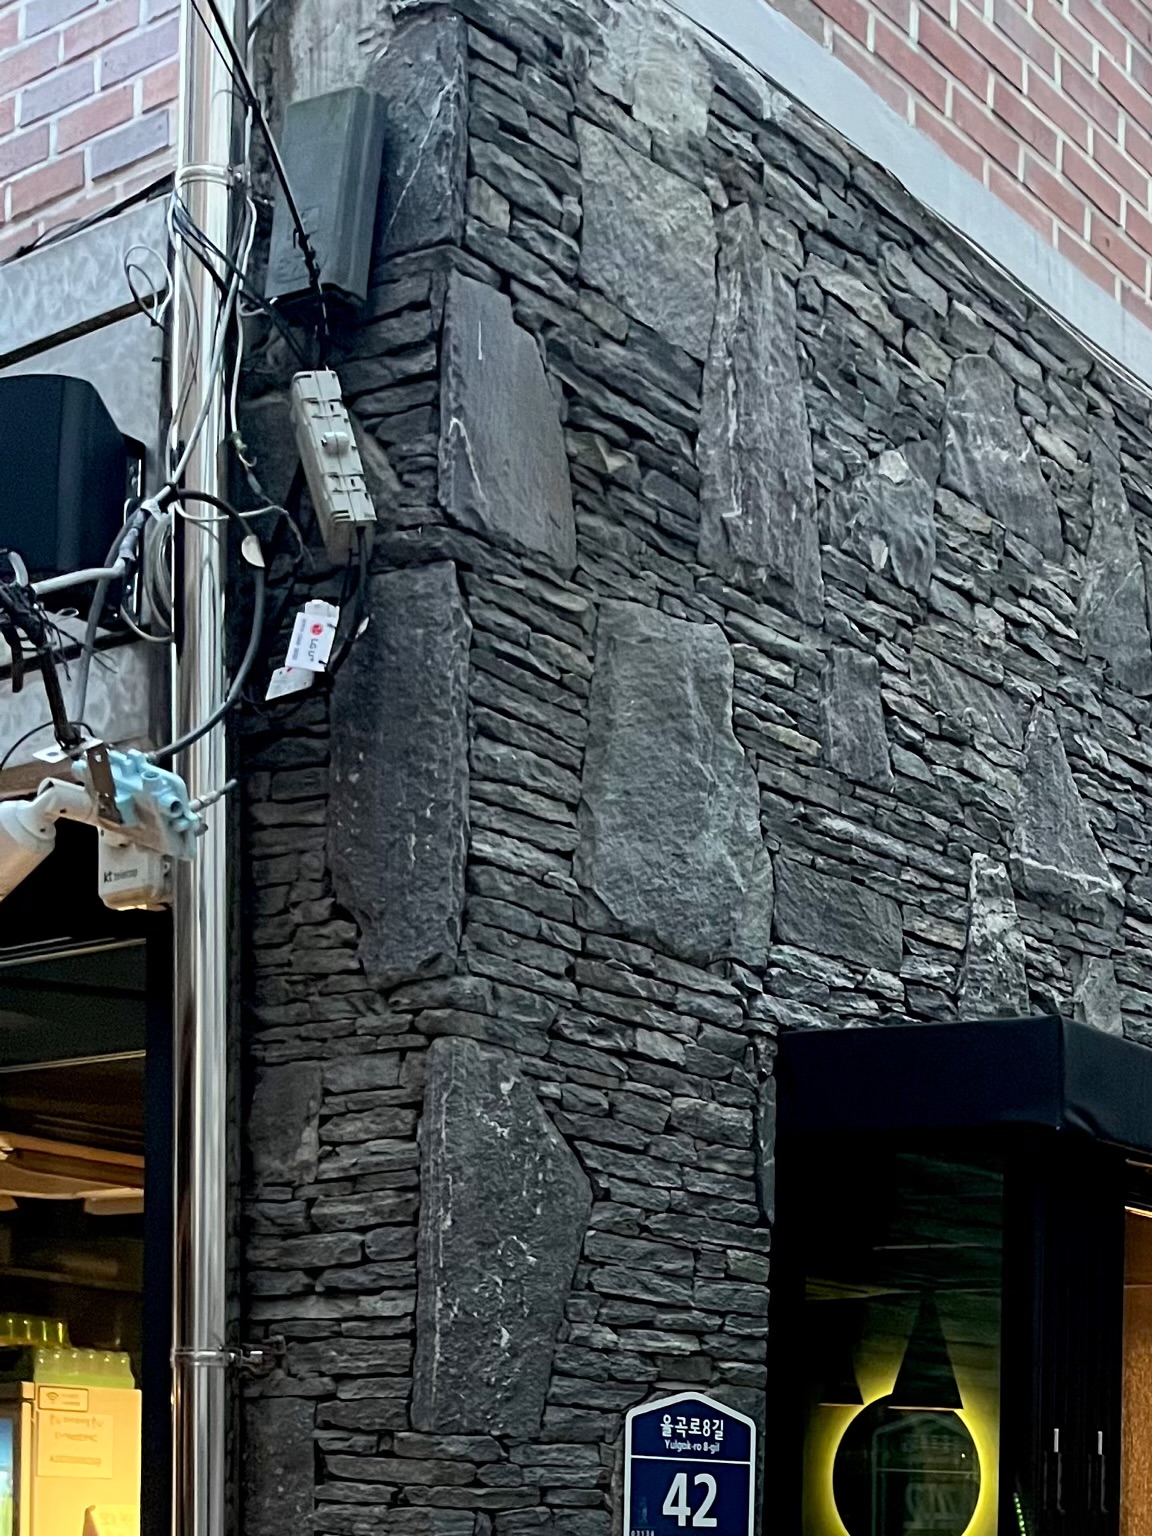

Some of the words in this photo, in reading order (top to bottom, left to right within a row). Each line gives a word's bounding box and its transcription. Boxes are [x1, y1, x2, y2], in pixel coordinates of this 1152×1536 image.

[660, 1414, 724, 1440] 율곡로8길
[664, 1439, 702, 1452] Yulgok-ro
[702, 1441, 720, 1454] 8-gil
[662, 1472, 717, 1528] 42
